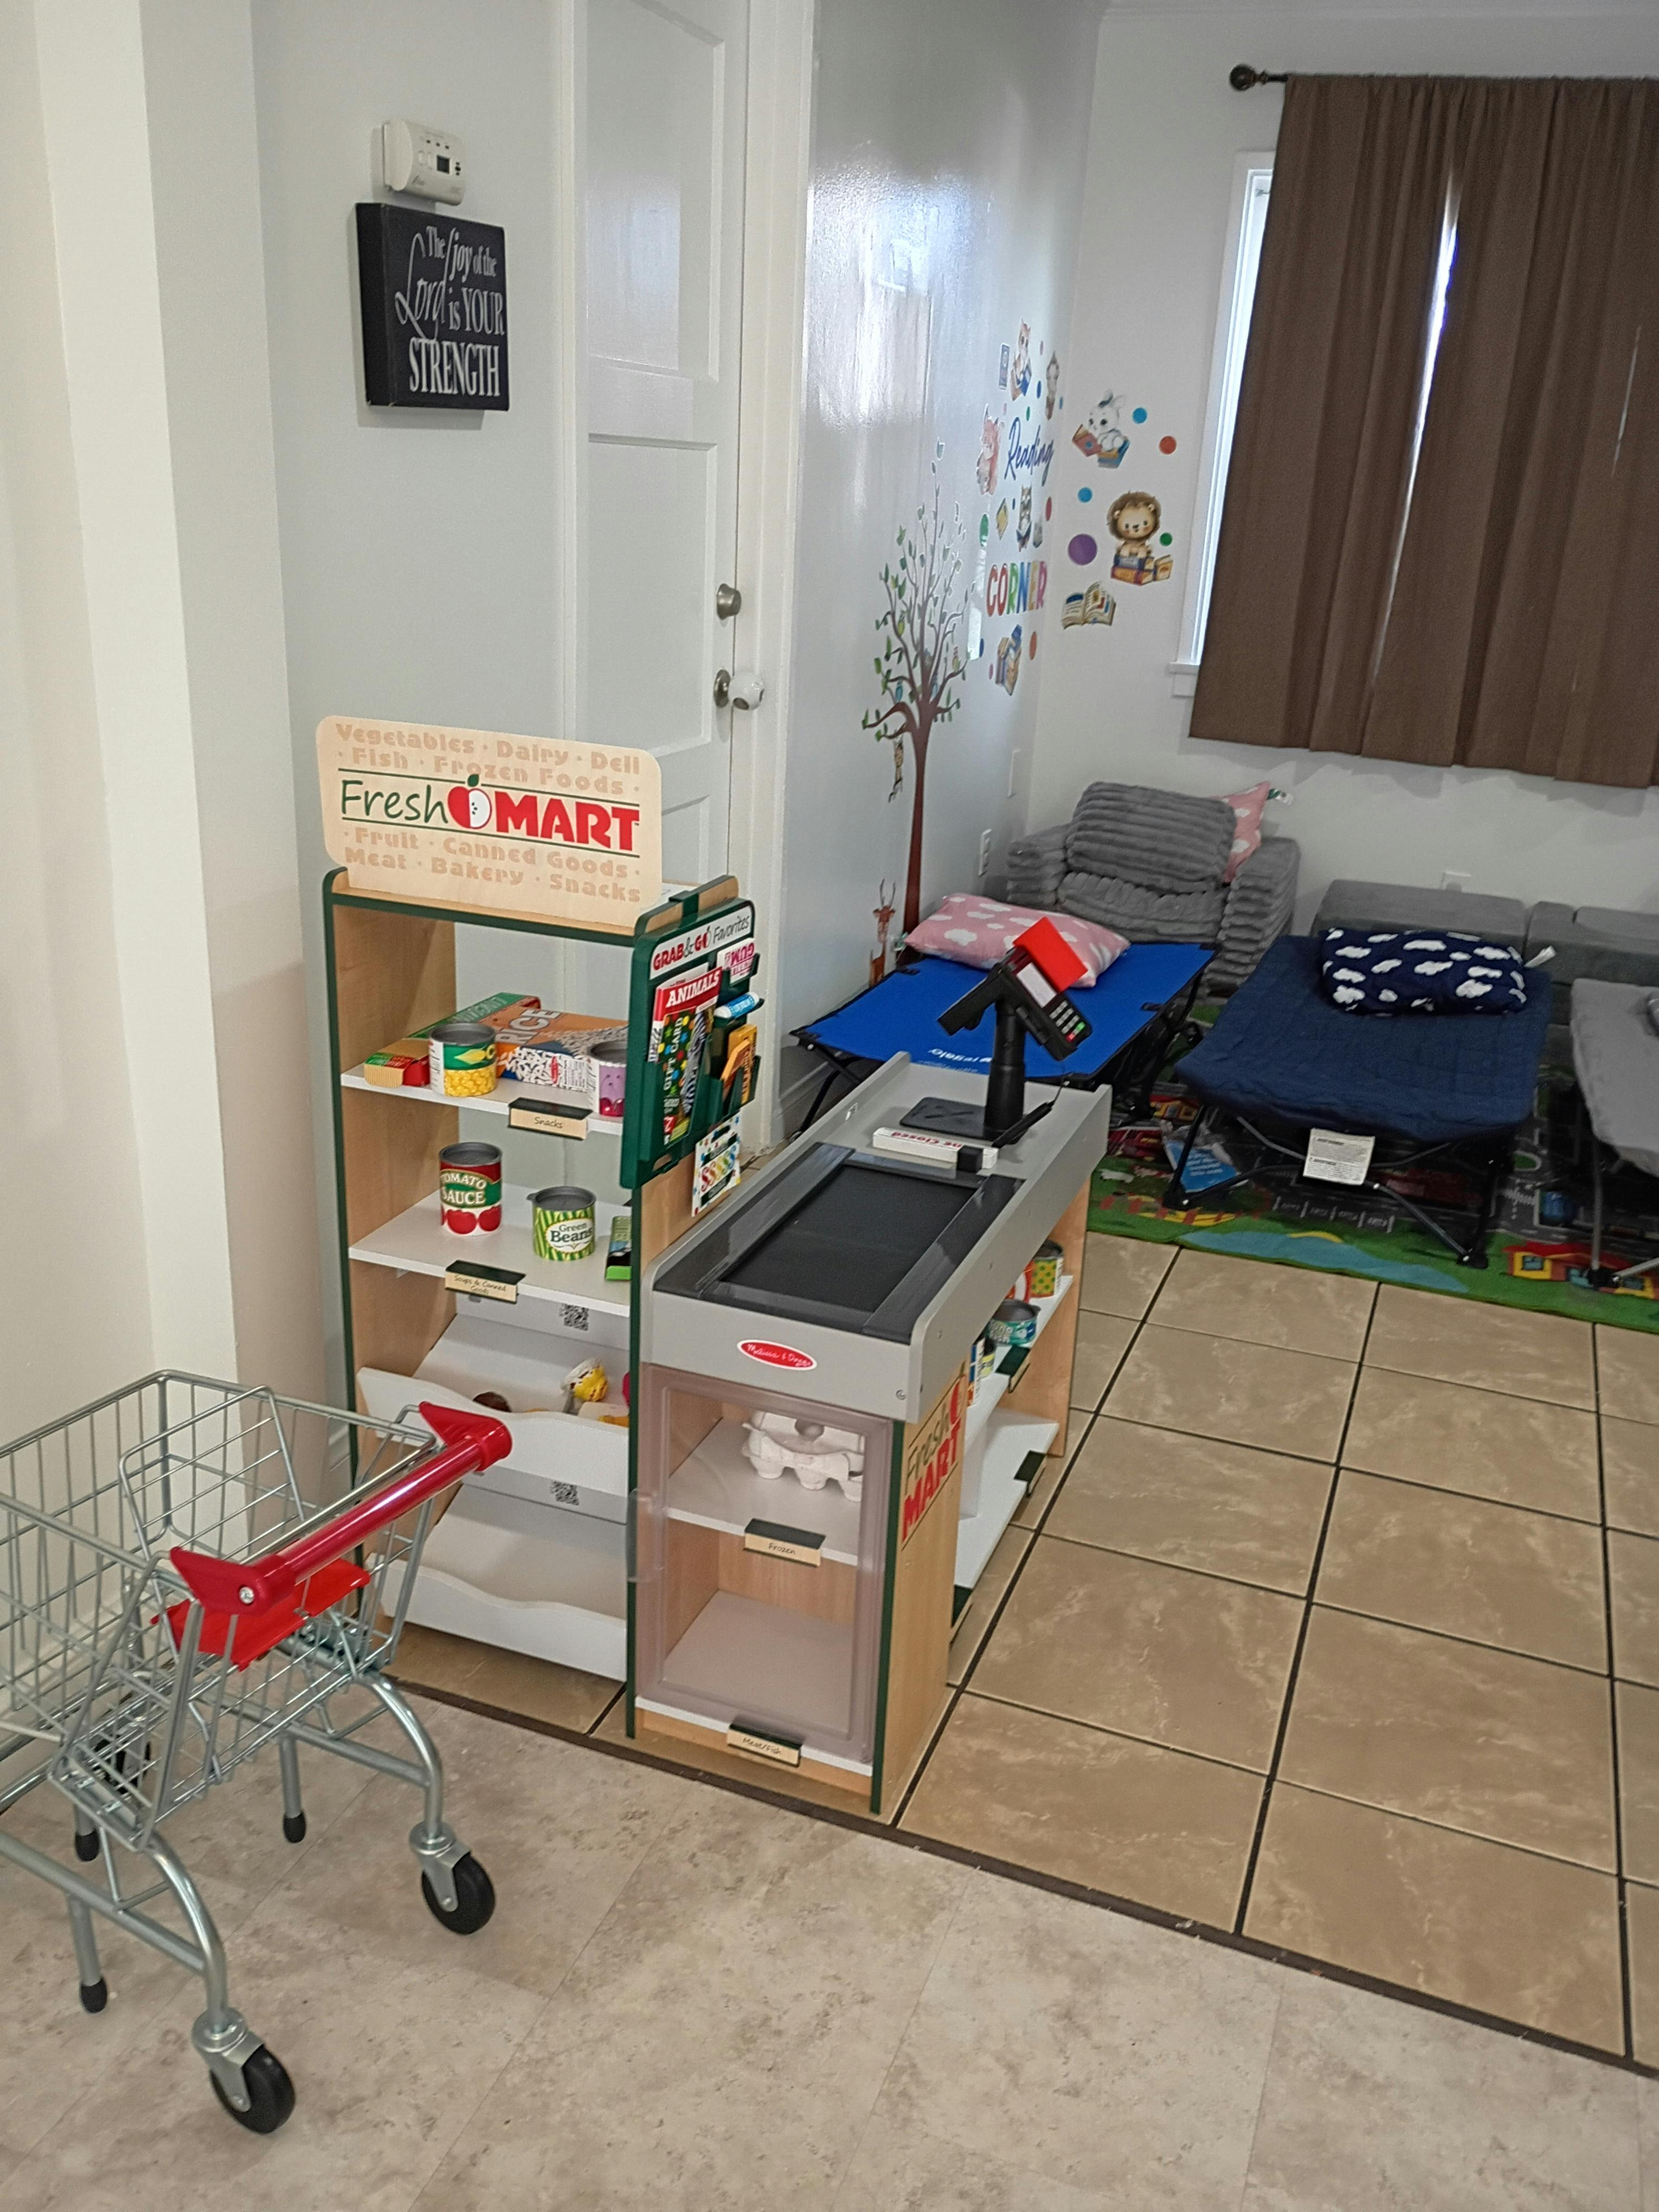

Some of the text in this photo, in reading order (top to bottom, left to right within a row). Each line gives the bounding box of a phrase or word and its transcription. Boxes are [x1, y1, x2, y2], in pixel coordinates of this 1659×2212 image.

[426, 226, 497, 283] The joy of the
[395, 228, 505, 340] Lord is YOUR
[409, 337, 500, 396] STRENGTH
[1004, 417, 1055, 486] Reading
[986, 561, 1047, 617] CORNER
[335, 723, 640, 775] Vegetables Dairy Deli
[352, 747, 623, 795] Fish Frozen Foods
[342, 779, 640, 851] Fresh MART
[345, 847, 640, 902] Meat Bakery Snacks
[355, 827, 628, 878] Fruit Canned Goods
[713, 916, 750, 944] Favorites
[665, 970, 721, 1008] ANIMALS
[494, 1008, 562, 1046] RICE
[670, 1017, 683, 1053] CARD
[534, 1116, 564, 1129] Snacks
[441, 1186, 486, 1205] SAUCE
[550, 1229, 593, 1243] Beans
[558, 1221, 587, 1233] Green
[902, 1403, 961, 1545] Fresh MART
[768, 1542, 797, 1555] Frozen
